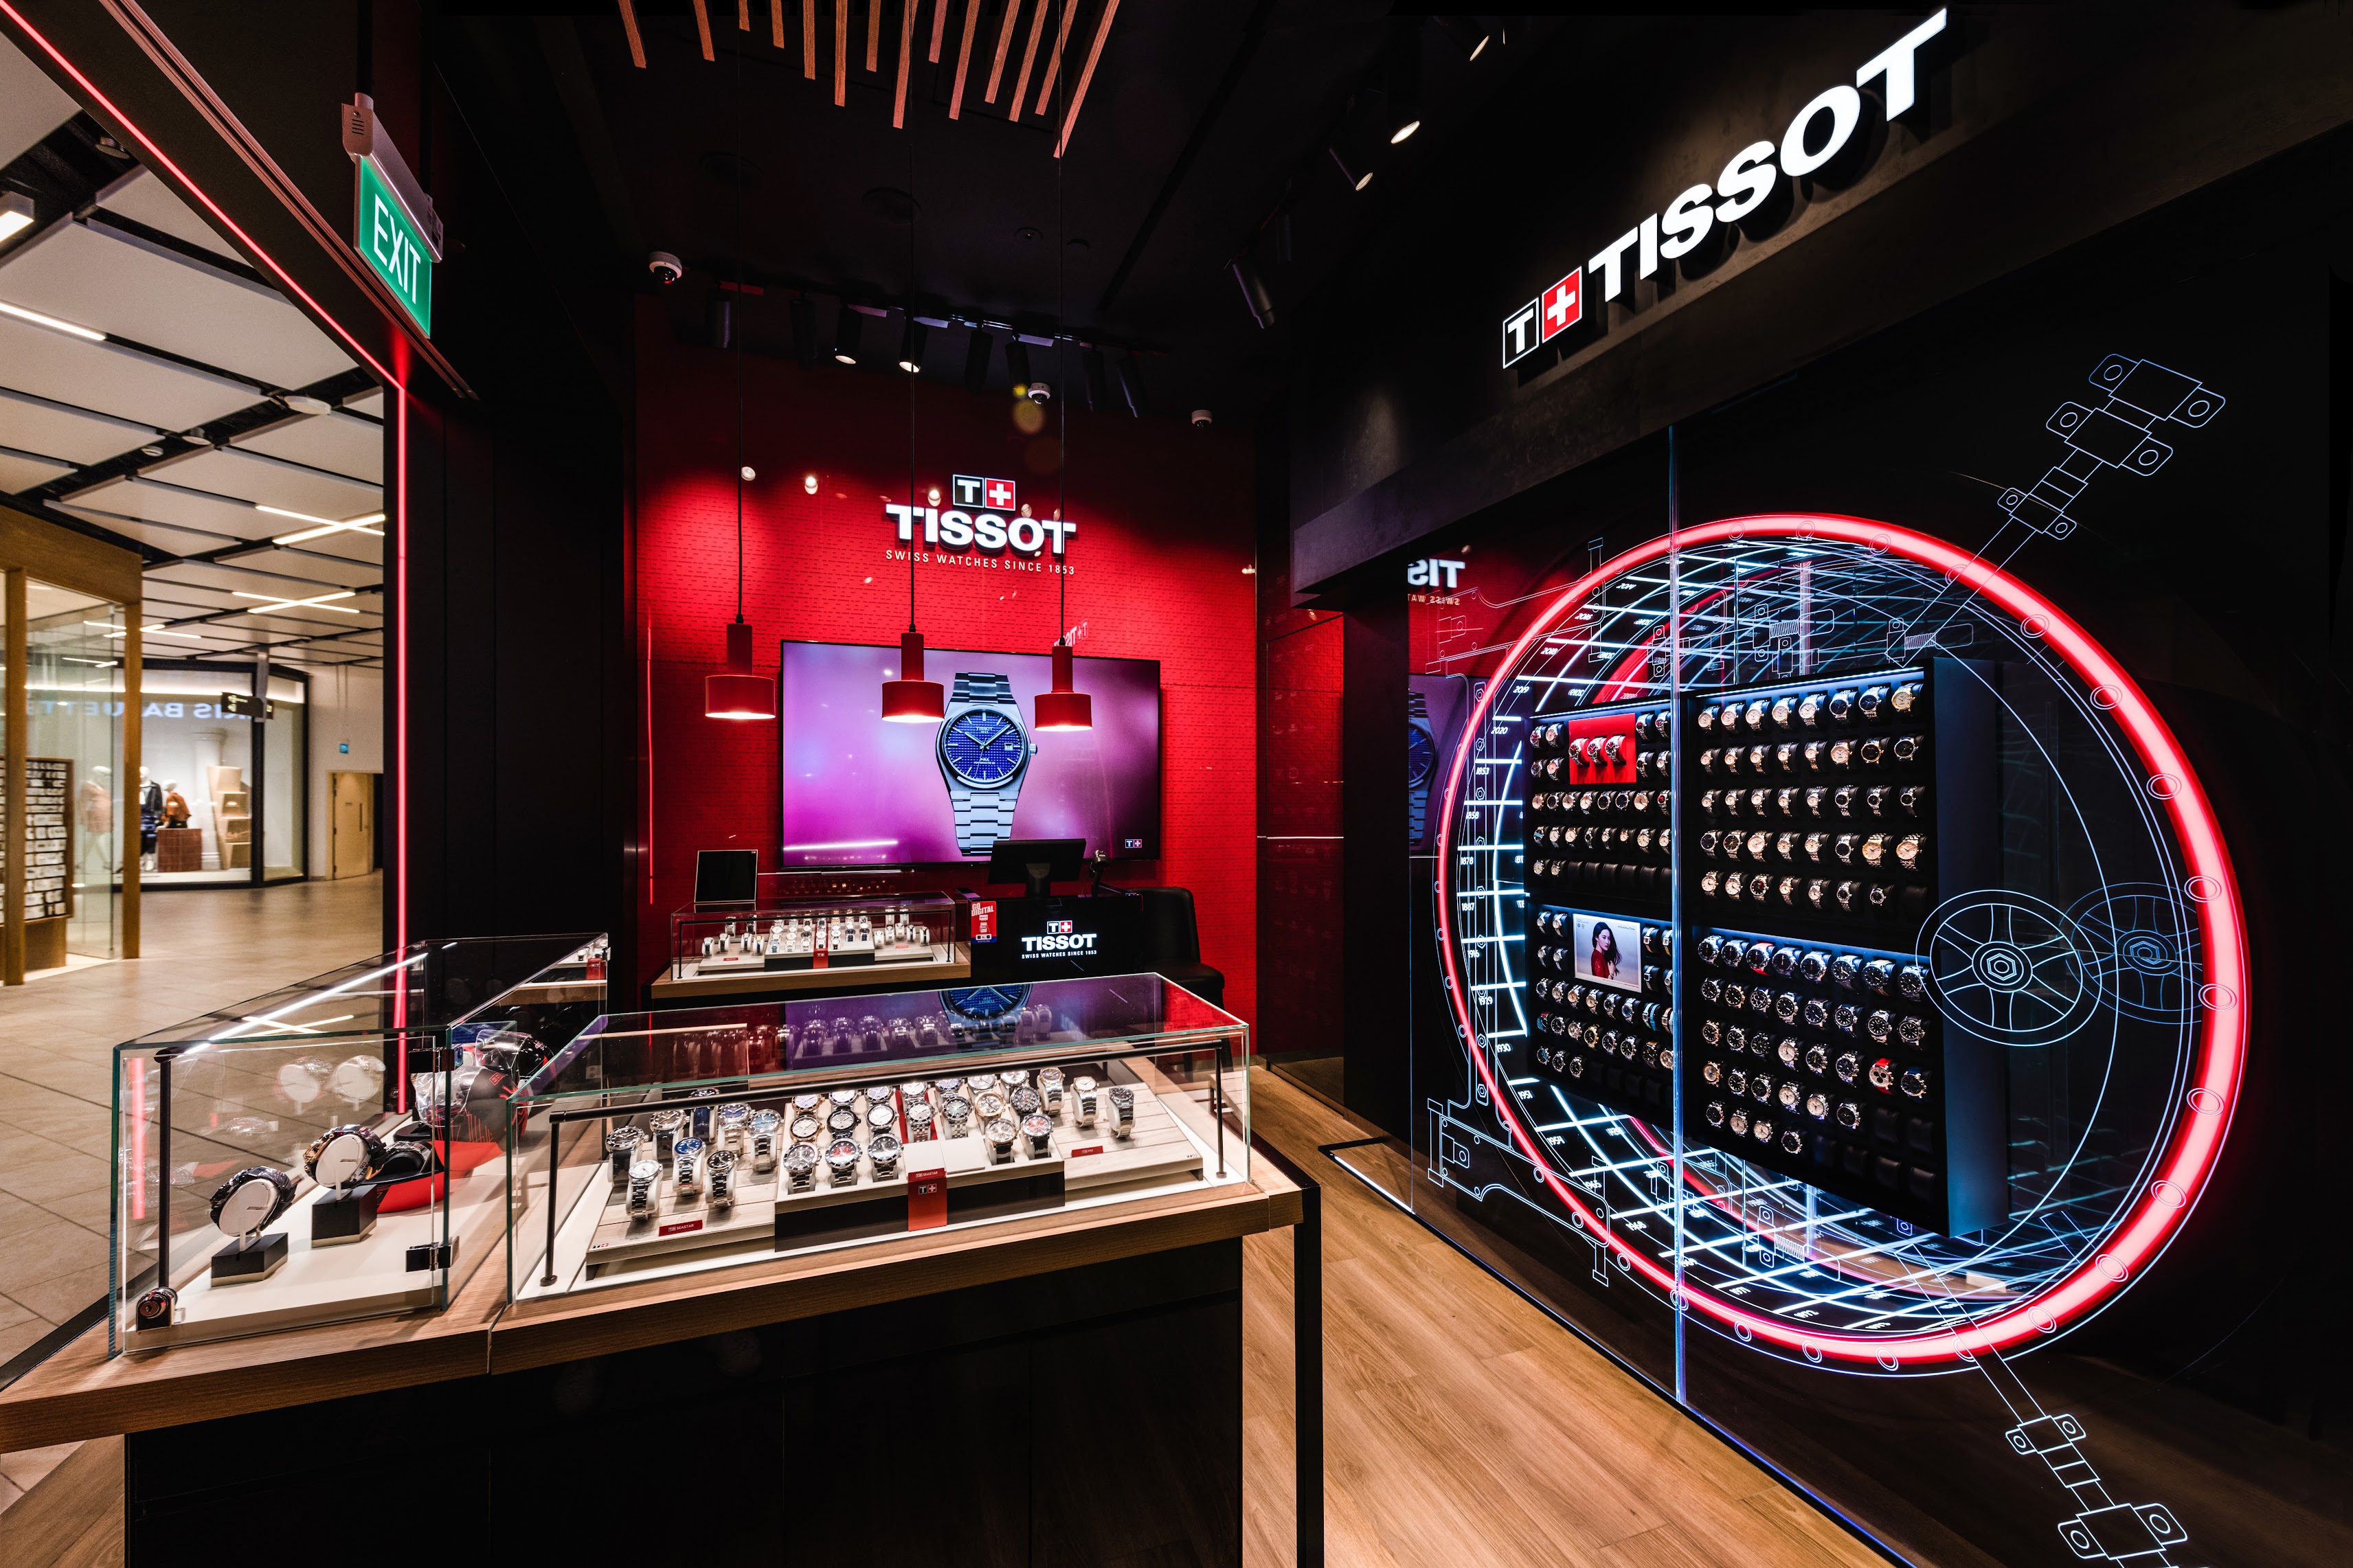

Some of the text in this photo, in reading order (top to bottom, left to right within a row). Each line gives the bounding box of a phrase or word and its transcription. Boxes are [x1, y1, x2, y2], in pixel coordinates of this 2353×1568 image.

[1588, 8, 1947, 302] TISSOT
[374, 193, 421, 304] EXIT
[886, 503, 1077, 554] TISSOT
[886, 549, 1074, 576] SWISS WATCHES SINCE 1853
[1541, 647, 1559, 655] 2018
[1513, 685, 1530, 694] 2019
[1476, 767, 1489, 775] 1853
[1465, 811, 1479, 819] 1858
[1461, 856, 1474, 865] 1878
[971, 905, 995, 917] DIGITAL
[1461, 902, 1475, 911] 1887
[1022, 933, 1097, 951] TISSOT
[1467, 949, 1480, 958] 1916
[1478, 996, 1493, 1005] 1929
[1496, 1043, 1511, 1053] 1930
[1518, 1090, 1533, 1100] 1951
